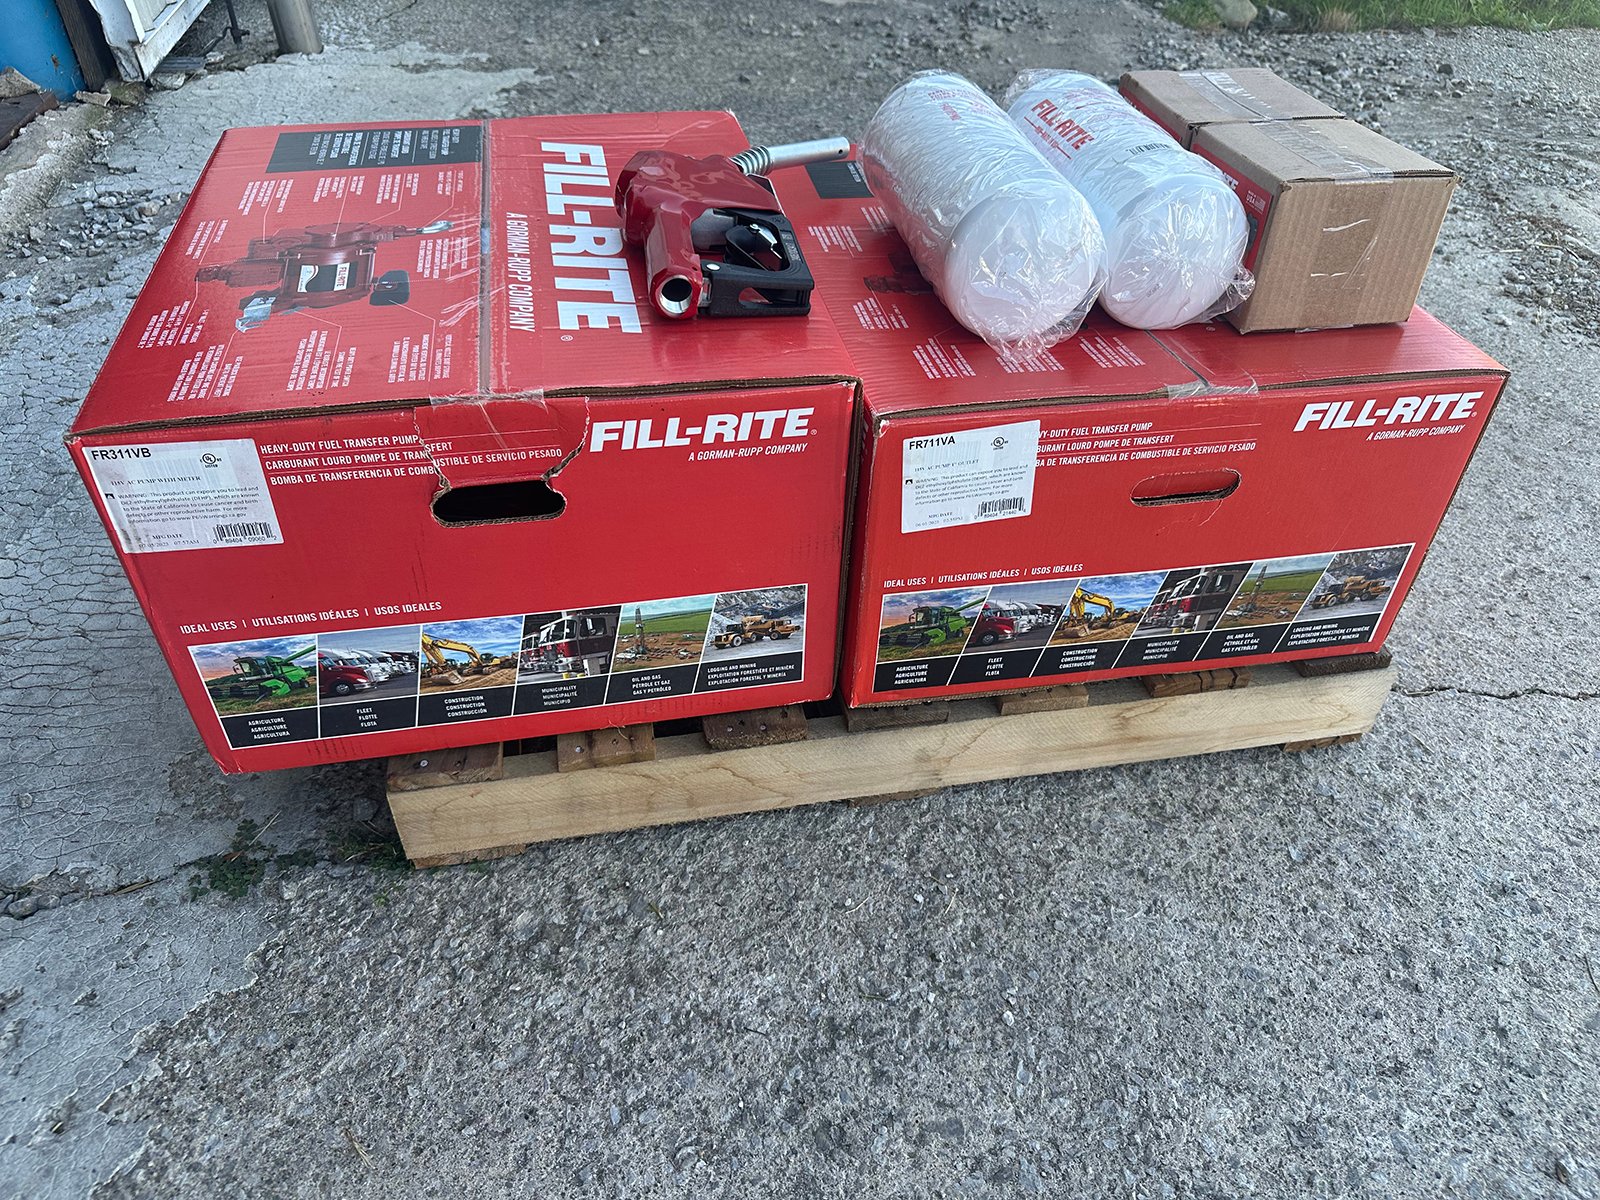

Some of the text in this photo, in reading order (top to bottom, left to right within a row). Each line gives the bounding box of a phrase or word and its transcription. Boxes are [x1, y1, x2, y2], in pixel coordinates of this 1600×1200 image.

[1031, 98, 1095, 151] FILL-RITE
[541, 142, 642, 333] FILL-RITE
[507, 222, 531, 281] GORMAN-RUPP
[510, 283, 535, 332] COMPANY
[1293, 391, 1484, 432] FILL-RITE
[589, 407, 815, 452] FILL-RITE
[1039, 422, 1153, 438] VY-DUTY FUEL TRANSFER PUMP
[1366, 424, 1466, 441] A GORMAN-RUPP COMPANY
[260, 434, 419, 454] HEAVY-DUTY FUEL TRANSFER PUMP
[909, 435, 956, 450] FR711VA
[1037, 435, 1174, 453] BURANT LOURD POMPE DE TRANSFERT
[91, 447, 151, 461] FR311VB
[688, 443, 808, 461] A GORMAN-RUPP COMPANY
[1047, 458, 1056, 466] DE
[1059, 454, 1116, 464] TRANSFERENCIA
[1131, 449, 1180, 459] COMBUSTIBLE
[1194, 445, 1226, 454] SERVICIO
[1228, 443, 1255, 451] PESADO
[266, 458, 318, 469] CARBURANT
[322, 456, 351, 465] LOURD
[354, 453, 386, 463] POMPE
[389, 452, 401, 460] DE
[271, 475, 303, 485] BOMBA
[305, 474, 317, 482] DE
[319, 469, 392, 481] TRANSFERENCIA
[394, 468, 406, 476] DE
[472, 455, 483, 463] DE
[486, 452, 526, 462] SERVICIO
[529, 449, 561, 458] PESADO
[907, 577, 926, 585] USES
[939, 572, 987, 583] UTILISATIONS
[989, 569, 1019, 578] IDÉALES
[1053, 564, 1083, 573] IDEALES
[180, 602, 441, 633] IDEAL USES UTILISATIONS IDÉALES USOS IDEALES
[1062, 648, 1098, 656] CONSTRUCTION
[1145, 646, 1177, 654] MUNICIPALITÉ
[1061, 654, 1096, 662] CONSTRUCTION
[896, 664, 928, 672] AGRICULTURE
[1059, 660, 1095, 669] CONSTRUCCIÓN
[708, 671, 739, 679] EXPLOITATION
[740, 668, 768, 676] FORESTIÈRE
[895, 670, 927, 679] AGRICULTURE
[708, 677, 739, 685] EXPLOTACIÓN
[894, 677, 926, 685] AGRICULTURA
[541, 684, 576, 693] MUNICIPALITY
[444, 695, 484, 704] CONSTRUCTION
[542, 691, 577, 700] MUNICIPALITÉ
[446, 702, 485, 711] CONSTRUCTION
[543, 698, 571, 706] MUNICIPIO
[447, 708, 487, 717] CONSTRUCCIÓN
[248, 717, 284, 726] AGRICULTURE
[250, 724, 287, 733] AGRICULTURE
[253, 731, 290, 740] AGRICULTURA
